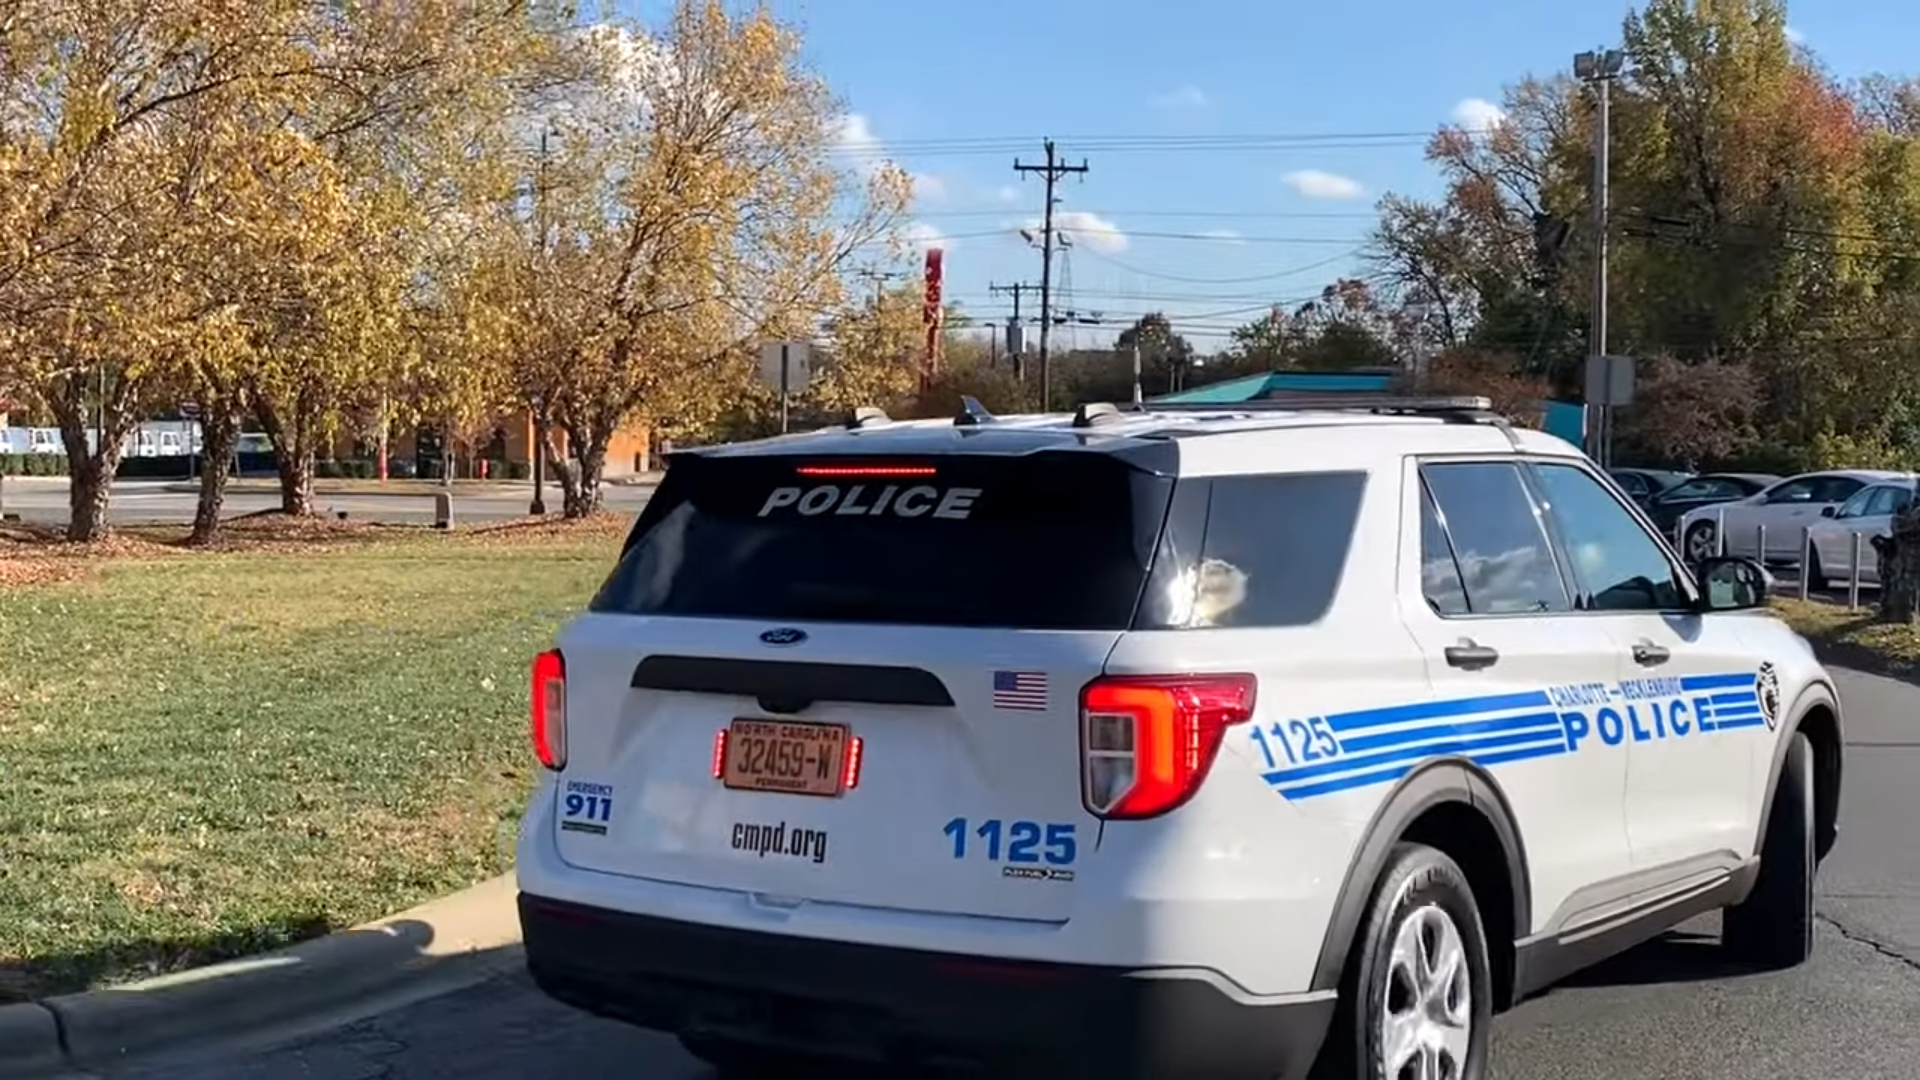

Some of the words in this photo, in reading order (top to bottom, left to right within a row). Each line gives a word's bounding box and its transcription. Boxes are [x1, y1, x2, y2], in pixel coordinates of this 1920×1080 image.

[757, 485, 983, 519] POLICE
[734, 723, 776, 737] NORTH
[782, 725, 839, 742] CAROLINA
[1250, 716, 1339, 769] 1125
[1560, 697, 1717, 752] POLICE
[737, 738, 832, 780] 32459-W
[566, 794, 612, 822] 911
[567, 781, 613, 797] EMERGENCY
[731, 821, 827, 864] cmpd.org
[943, 817, 1077, 865] 1125
